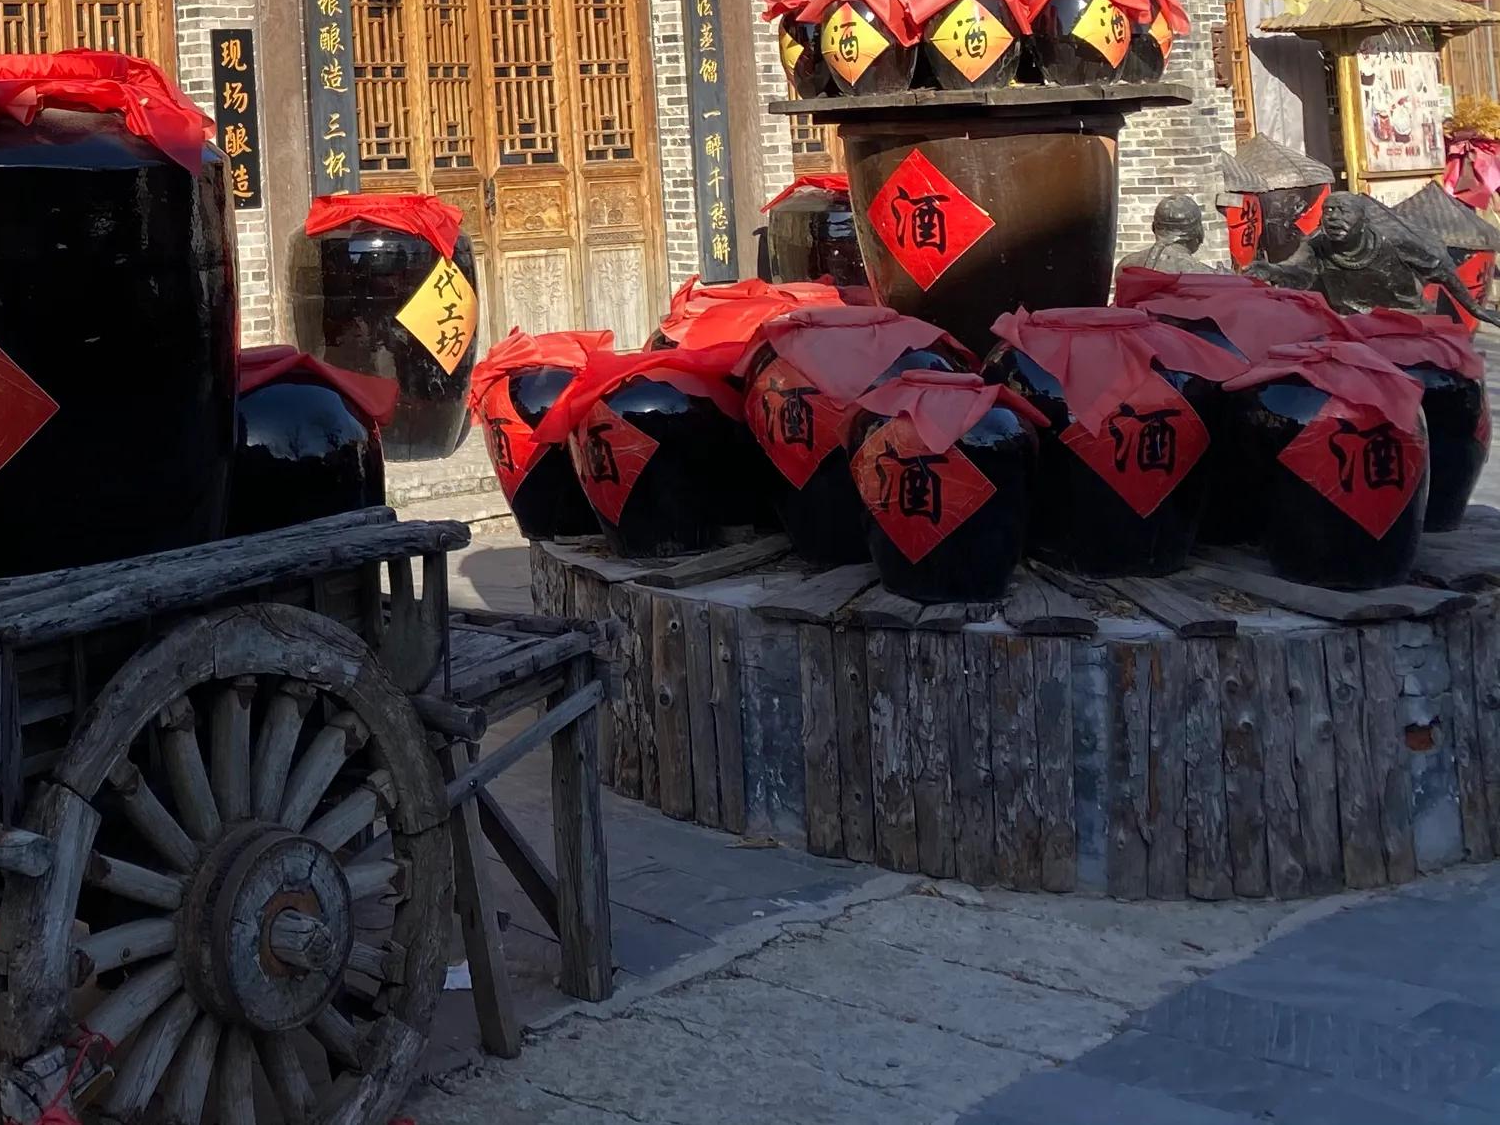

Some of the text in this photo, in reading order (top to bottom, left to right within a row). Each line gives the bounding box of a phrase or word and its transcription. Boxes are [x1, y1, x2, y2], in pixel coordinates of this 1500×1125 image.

[830, 22, 859, 63] 酒
[955, 17, 988, 58] 酒
[1100, 5, 1127, 43] 酒
[220, 39, 255, 200] 现场酿造
[890, 186, 951, 255] 酒
[433, 268, 466, 358] 代工坊
[762, 377, 820, 450] 酒
[1109, 403, 1182, 476] 酒
[875, 440, 949, 525] 酒
[1328, 419, 1405, 493] 酒
